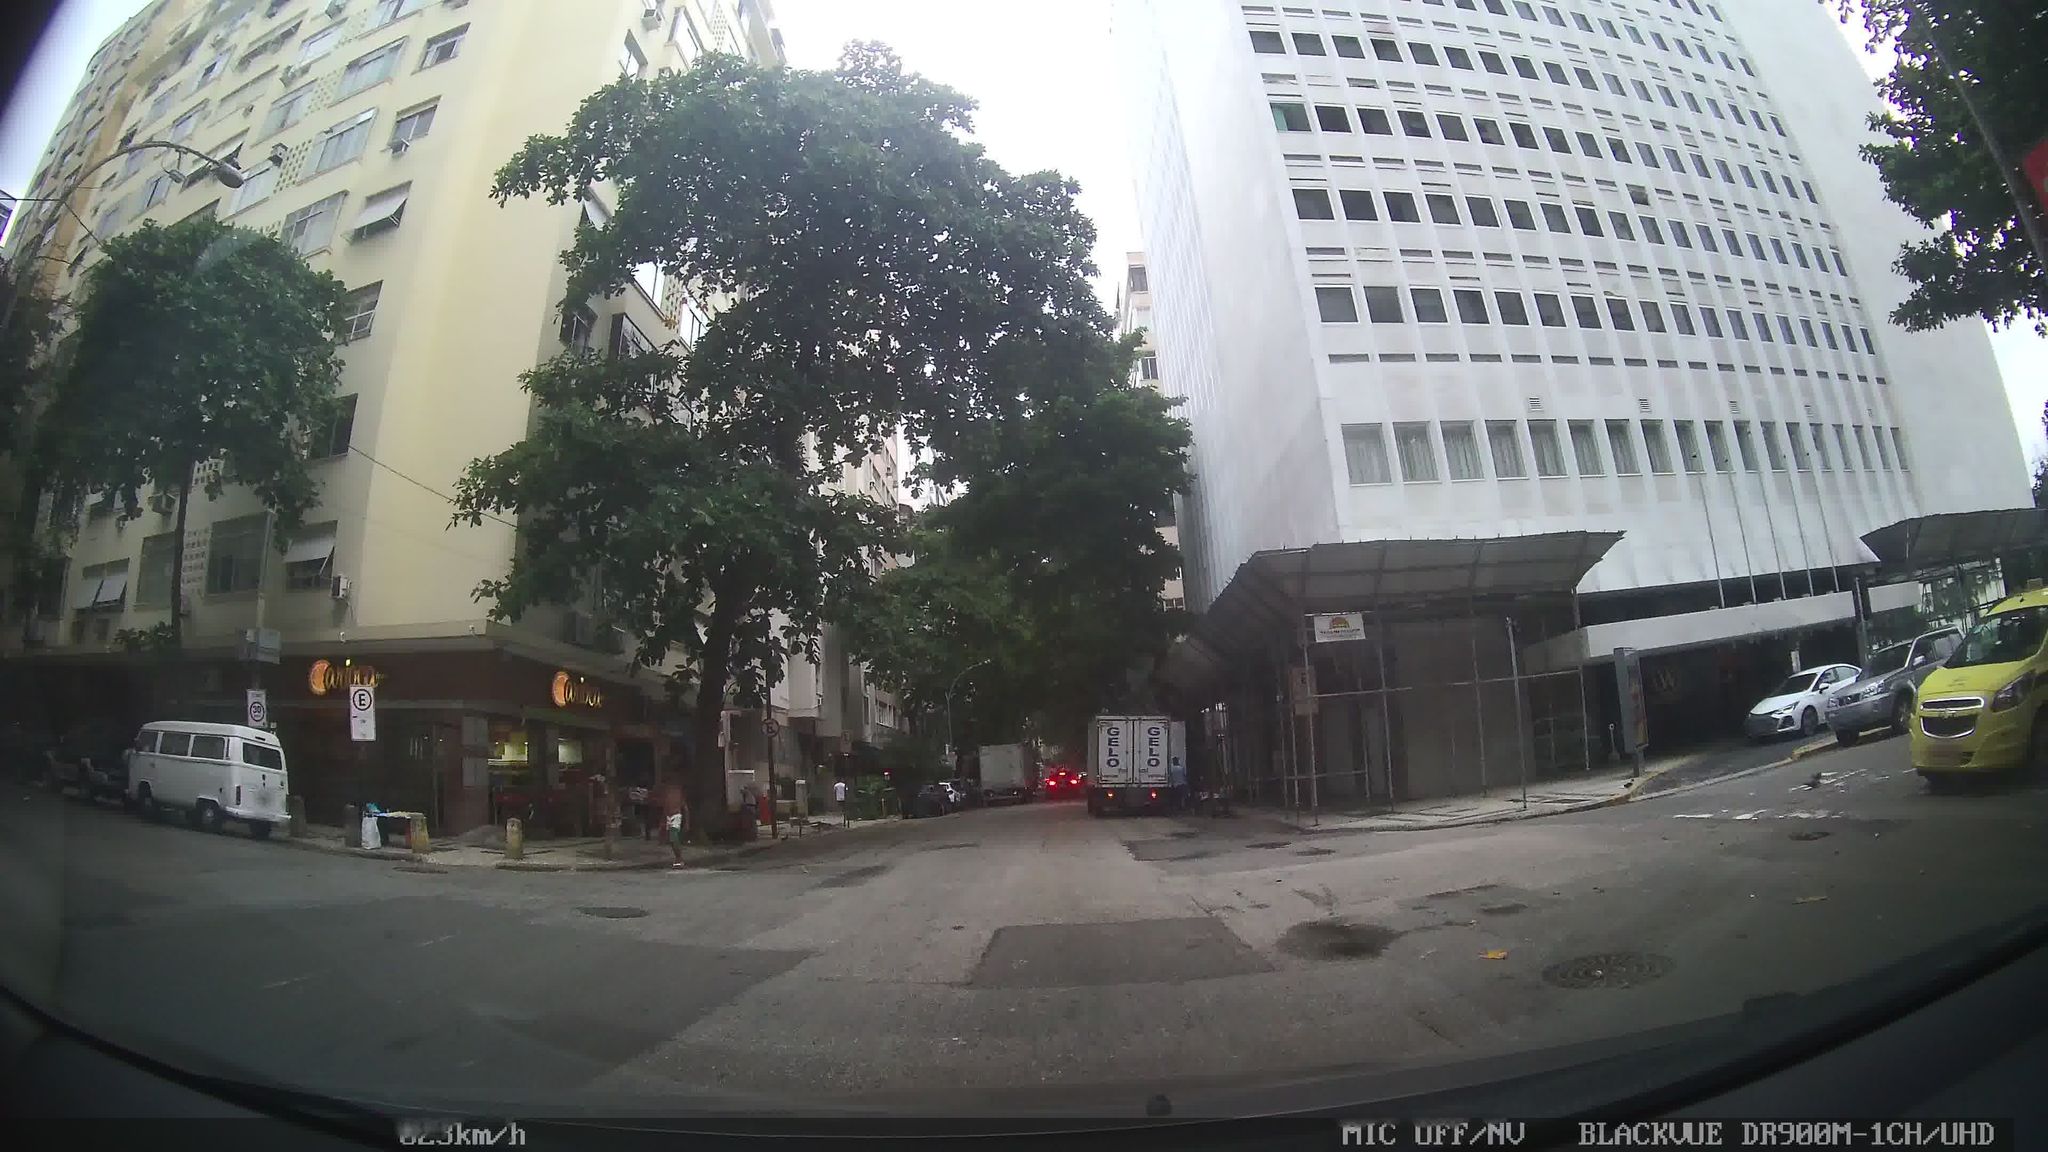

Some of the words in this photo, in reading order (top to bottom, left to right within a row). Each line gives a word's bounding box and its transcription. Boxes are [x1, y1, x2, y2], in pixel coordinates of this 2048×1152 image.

[358, 693, 366, 707] E
[1106, 727, 1120, 768] GELO
[1147, 727, 1161, 767] GELO
